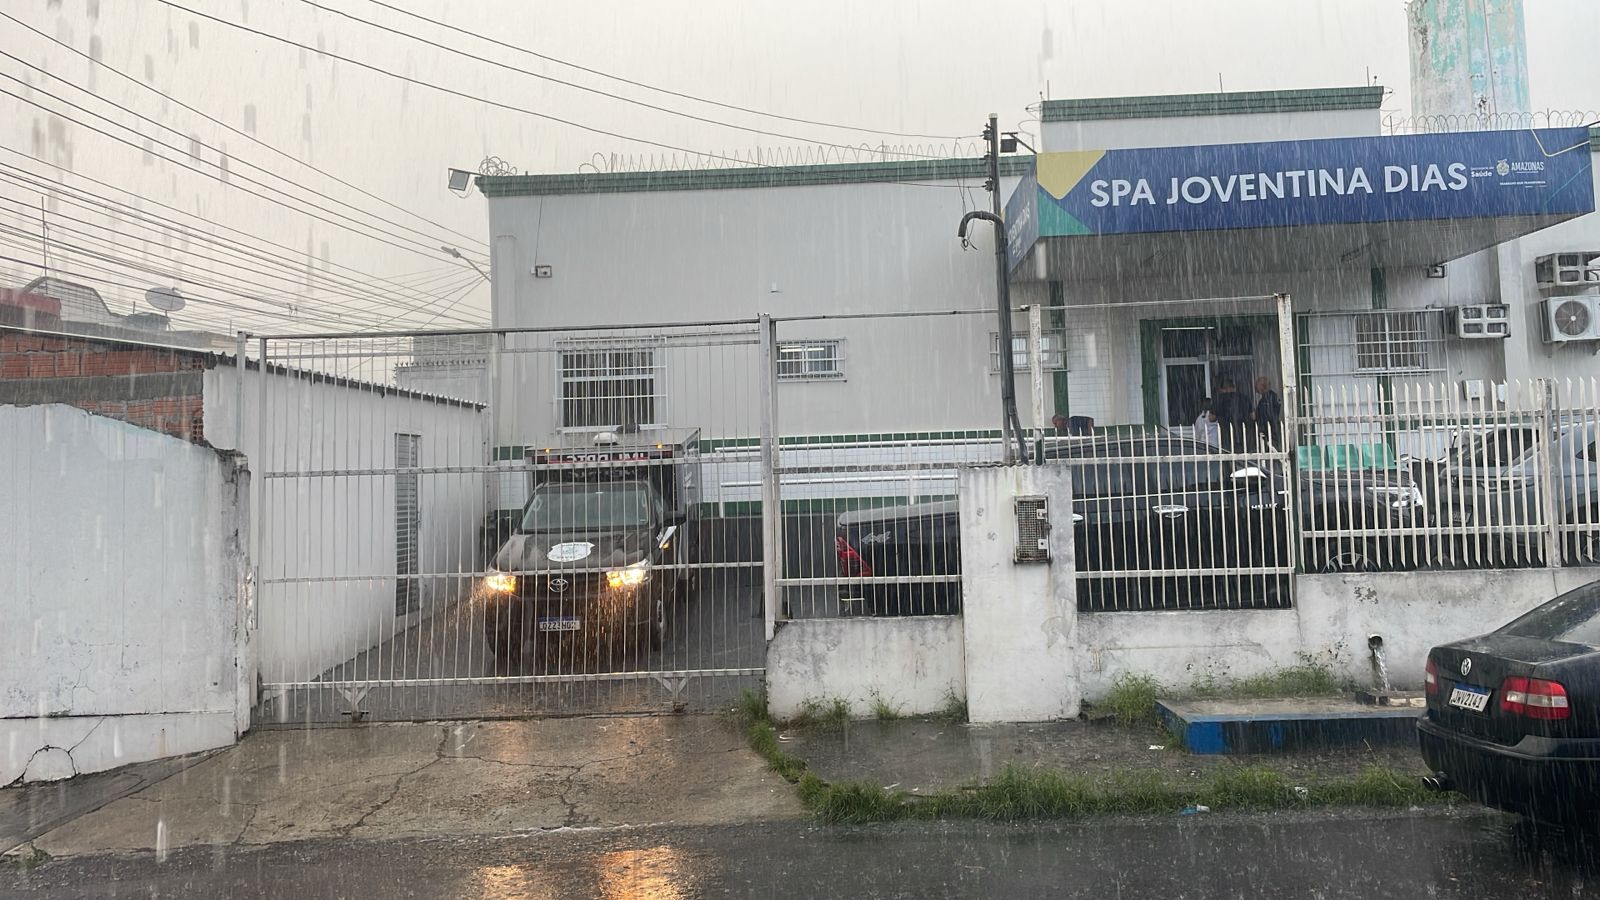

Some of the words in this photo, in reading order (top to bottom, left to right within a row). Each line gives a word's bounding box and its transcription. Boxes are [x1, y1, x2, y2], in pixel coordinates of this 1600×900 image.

[1511, 161, 1545, 171] AMAZONAS
[1090, 178, 1156, 207] SPA
[1166, 167, 1374, 205] JOVENTINA
[1384, 162, 1468, 193] DIAS
